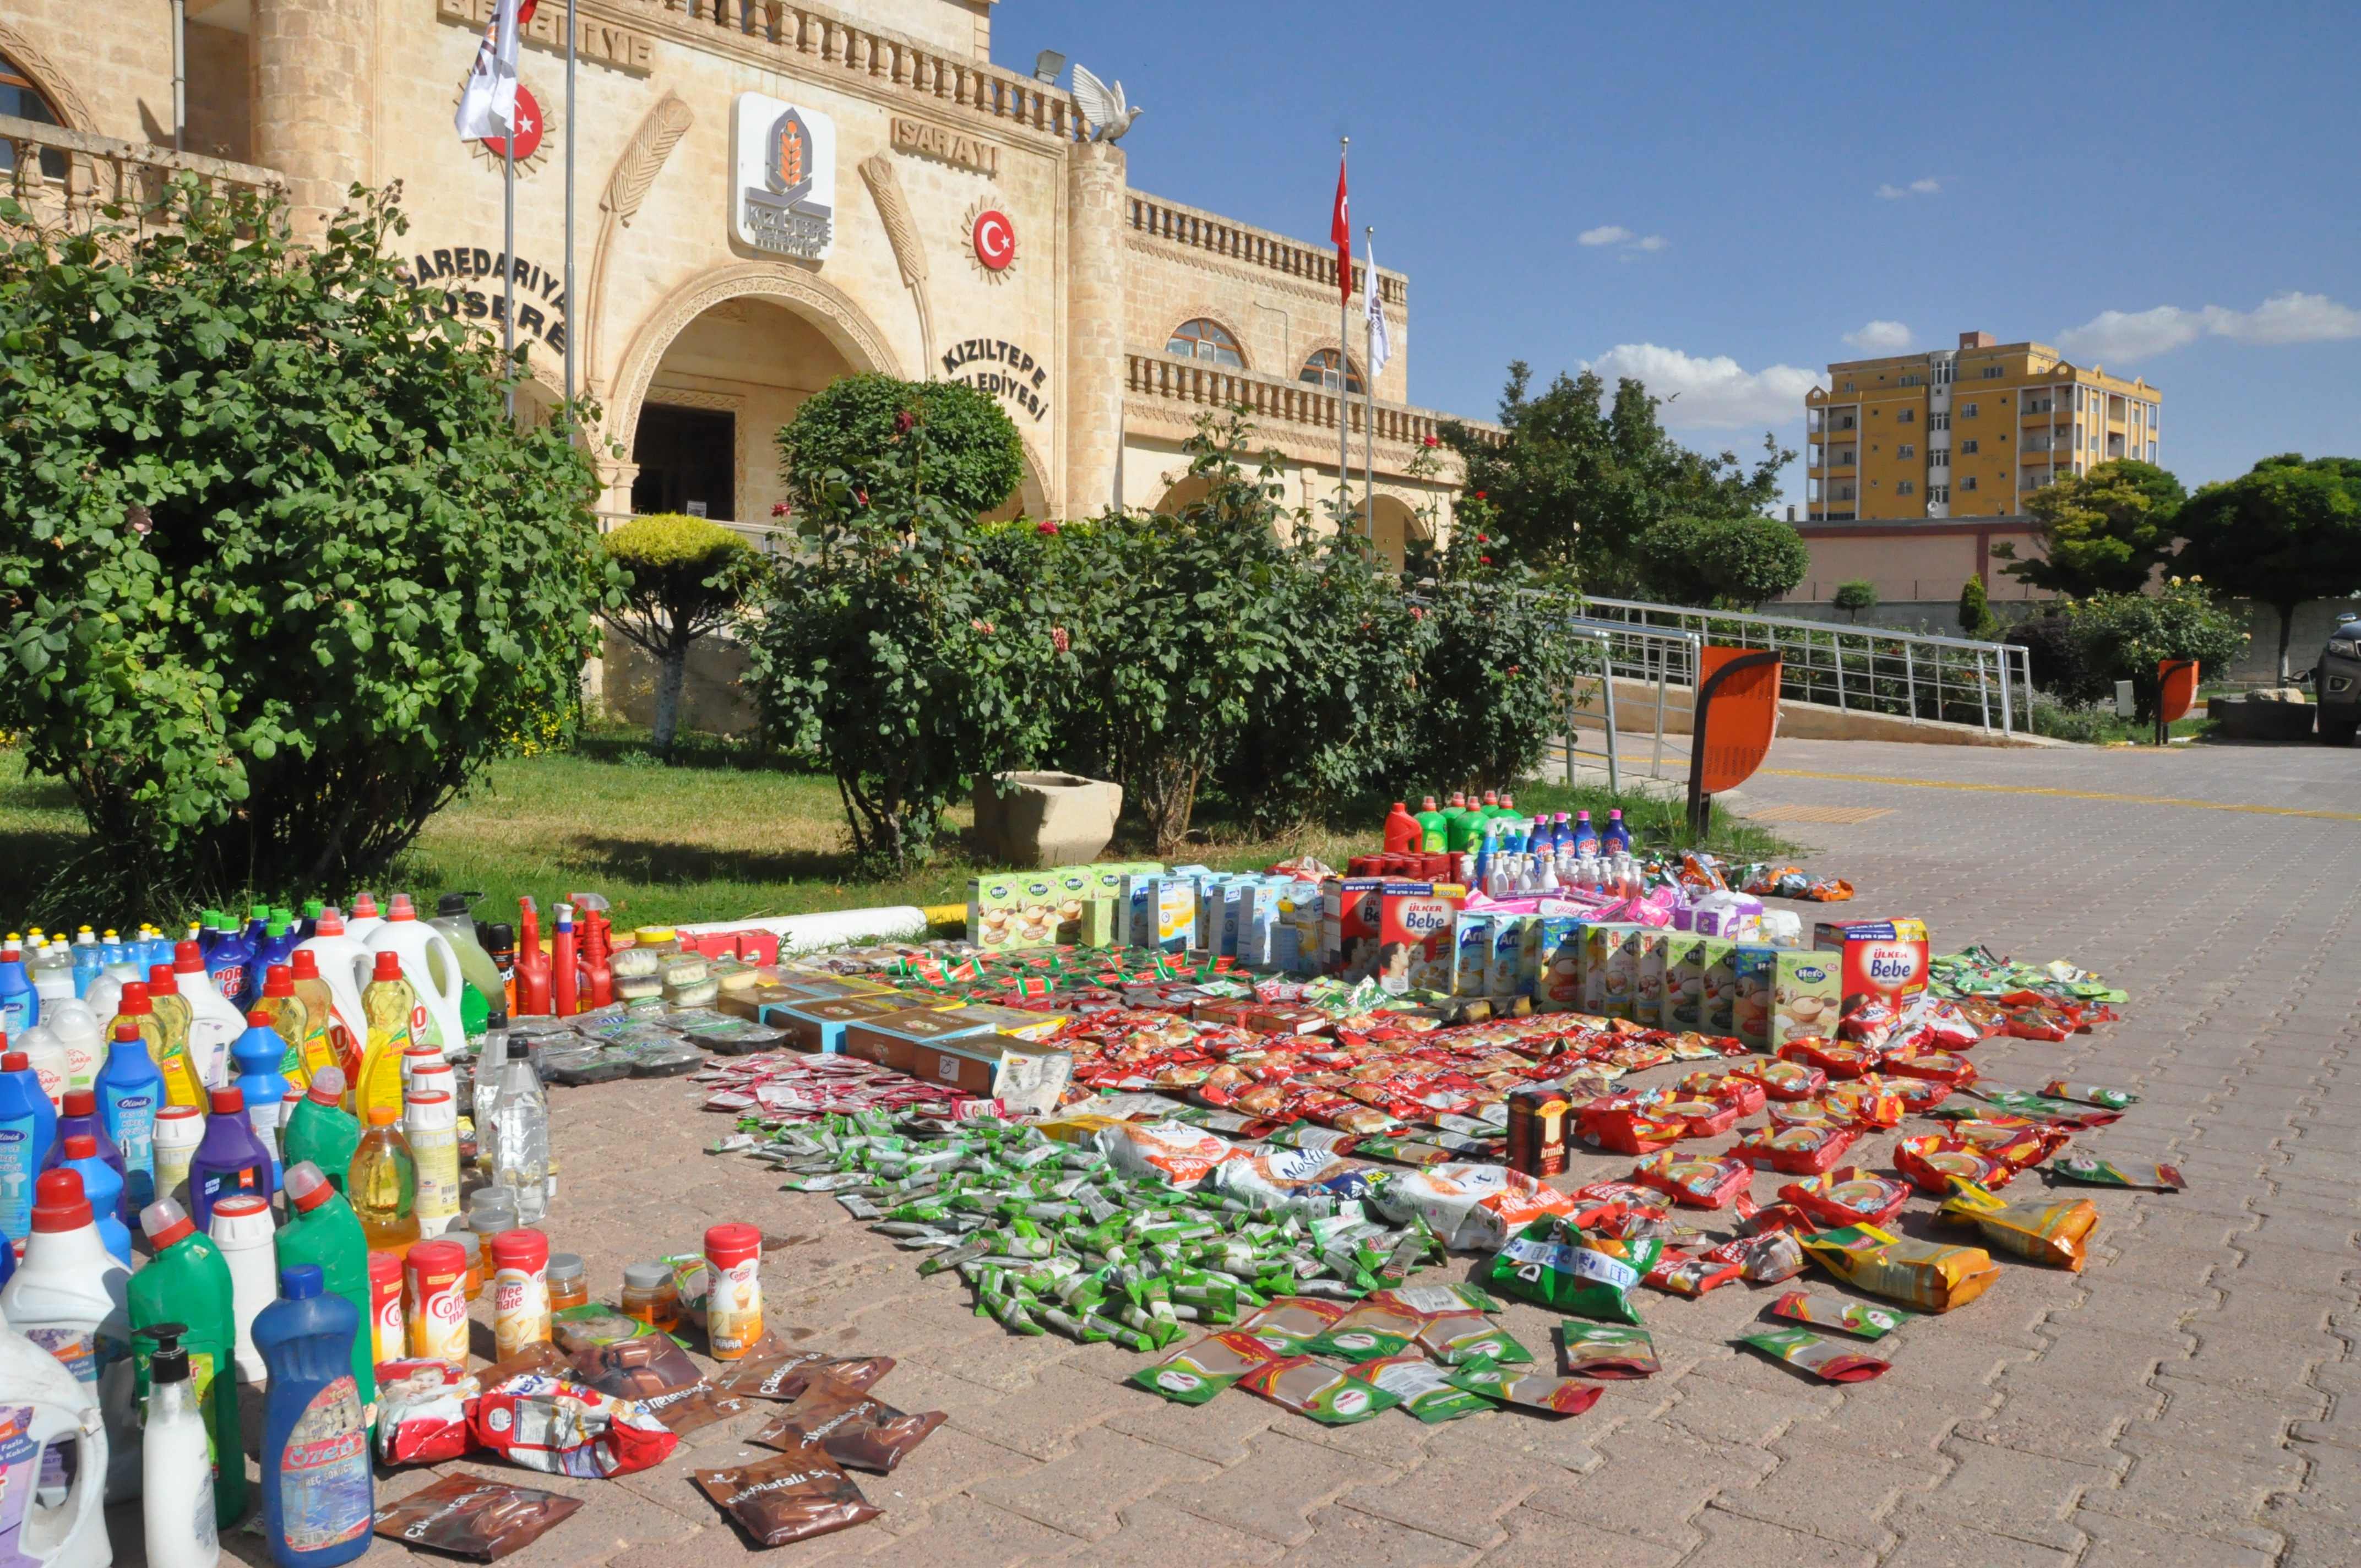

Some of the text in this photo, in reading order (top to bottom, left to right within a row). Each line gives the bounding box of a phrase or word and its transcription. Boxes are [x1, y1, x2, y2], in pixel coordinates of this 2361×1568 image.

[941, 338, 1047, 379] KIZILTEPE
[955, 369, 1049, 423] LEDİYESİ
[1363, 907, 1380, 922] Be
[1408, 903, 1443, 913] ÜLKER
[1405, 912, 1445, 929] Bebe
[214, 965, 243, 982] POR
[1798, 969, 1824, 978] Hero
[1870, 959, 1911, 977] Bebe
[940, 1058, 955, 1075] 25
[431, 1294, 465, 1319] Coffe
[69, 1360, 90, 1370] Fazla
[1, 1438, 24, 1452] Fazla
[6, 1442, 34, 1459] Kokusu
[288, 1439, 356, 1466] Özen
